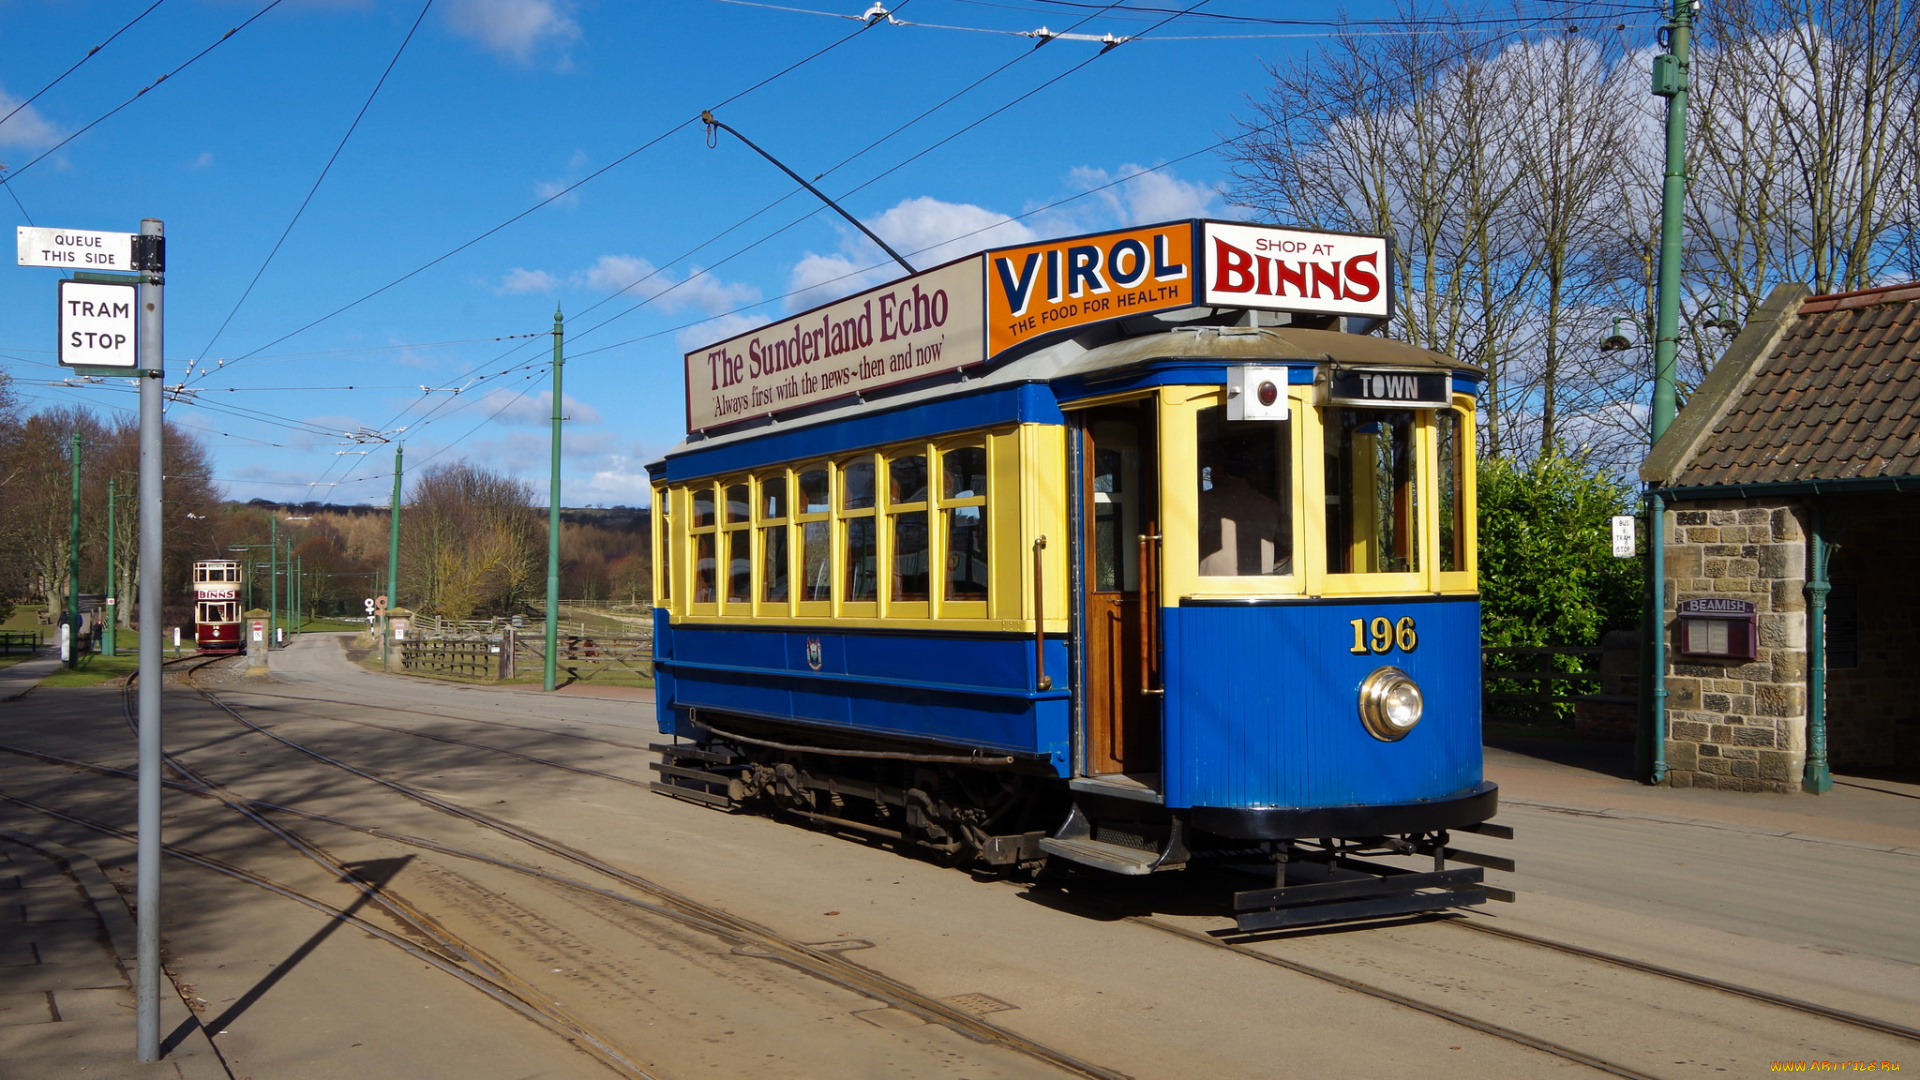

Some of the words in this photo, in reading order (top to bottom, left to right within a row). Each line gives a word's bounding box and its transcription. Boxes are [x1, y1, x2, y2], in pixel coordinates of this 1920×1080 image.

[55, 235, 102, 248] QUEUE
[1255, 238, 1307, 253] SHOP
[1312, 244, 1334, 256] AT
[42, 250, 75, 262] THIS
[85, 253, 115, 265] SIDE
[994, 233, 1188, 318] VIROL
[1212, 235, 1380, 302] BINNS
[68, 300, 129, 318] TRAM
[1009, 316, 1037, 337] THE
[1042, 304, 1078, 325] FOOD
[1083, 299, 1110, 314] FOR
[1117, 285, 1179, 308] HEALTH
[71, 331, 126, 349] STOP
[707, 347, 743, 391] The
[750, 299, 873, 380] Sunderland
[879, 283, 948, 342] Echo
[752, 385, 773, 408] first
[776, 375, 799, 401] with
[801, 371, 818, 395] the
[889, 342, 912, 373] and
[1360, 374, 1418, 399] TOWN
[1618, 519, 1630, 527] BUS
[199, 590, 234, 599] BINNS
[1689, 600, 1746, 612] BEAMISH
[1350, 616, 1419, 655] 196
